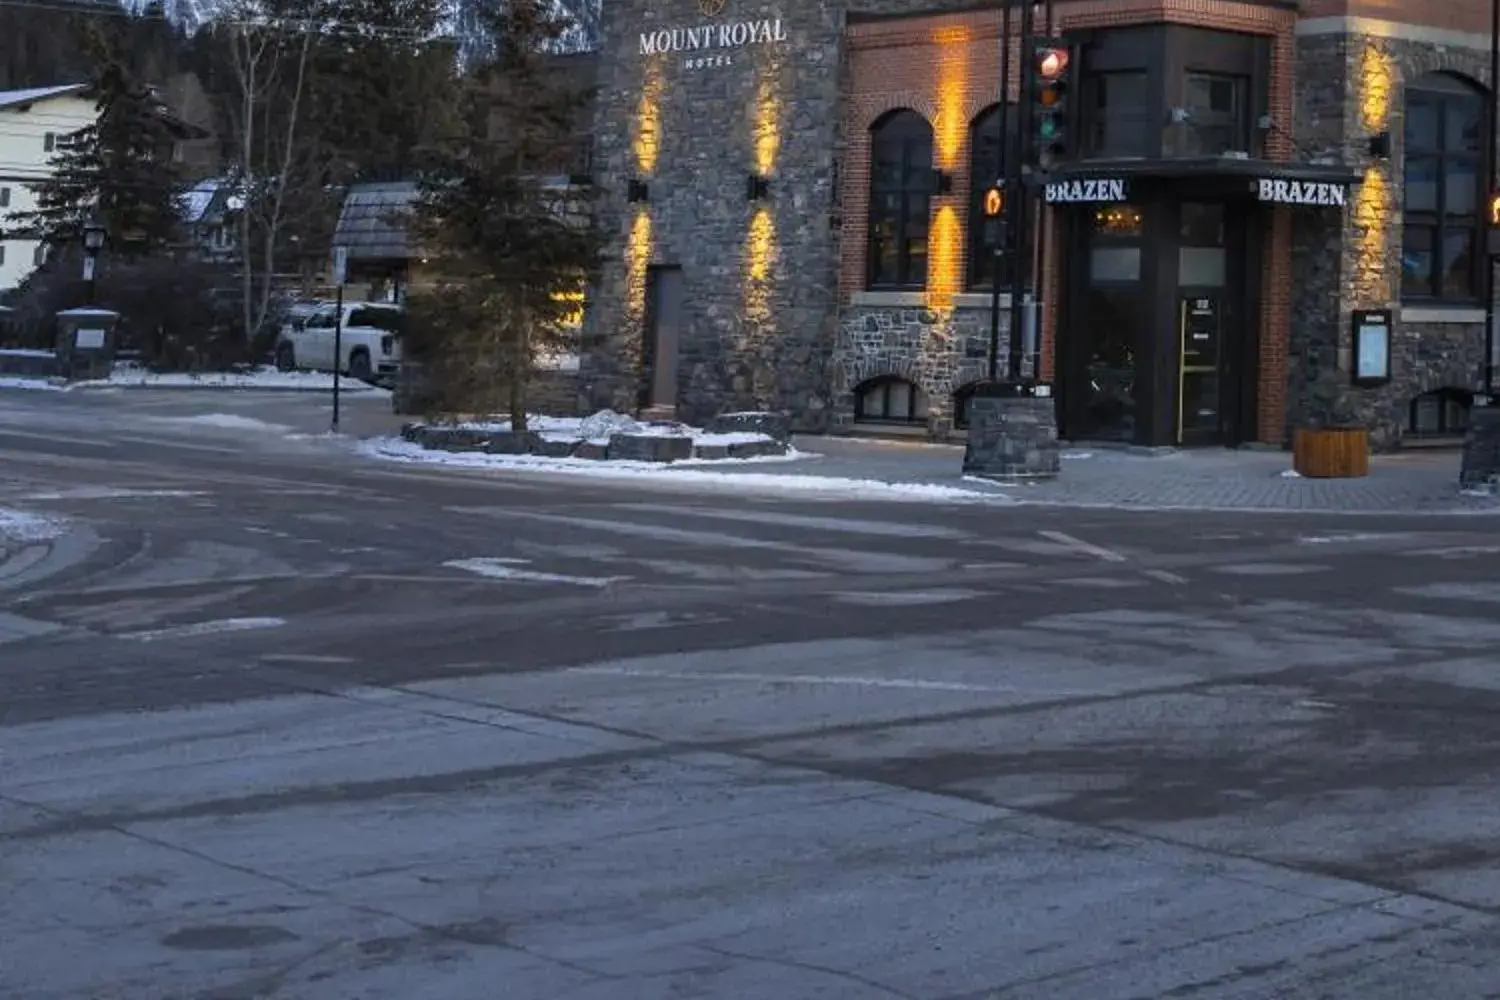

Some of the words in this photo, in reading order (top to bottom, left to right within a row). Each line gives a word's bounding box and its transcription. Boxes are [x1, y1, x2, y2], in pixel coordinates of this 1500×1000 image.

[639, 25, 715, 55] MOUNT
[719, 18, 787, 47] ROYAL
[685, 55, 732, 69] HOTEL
